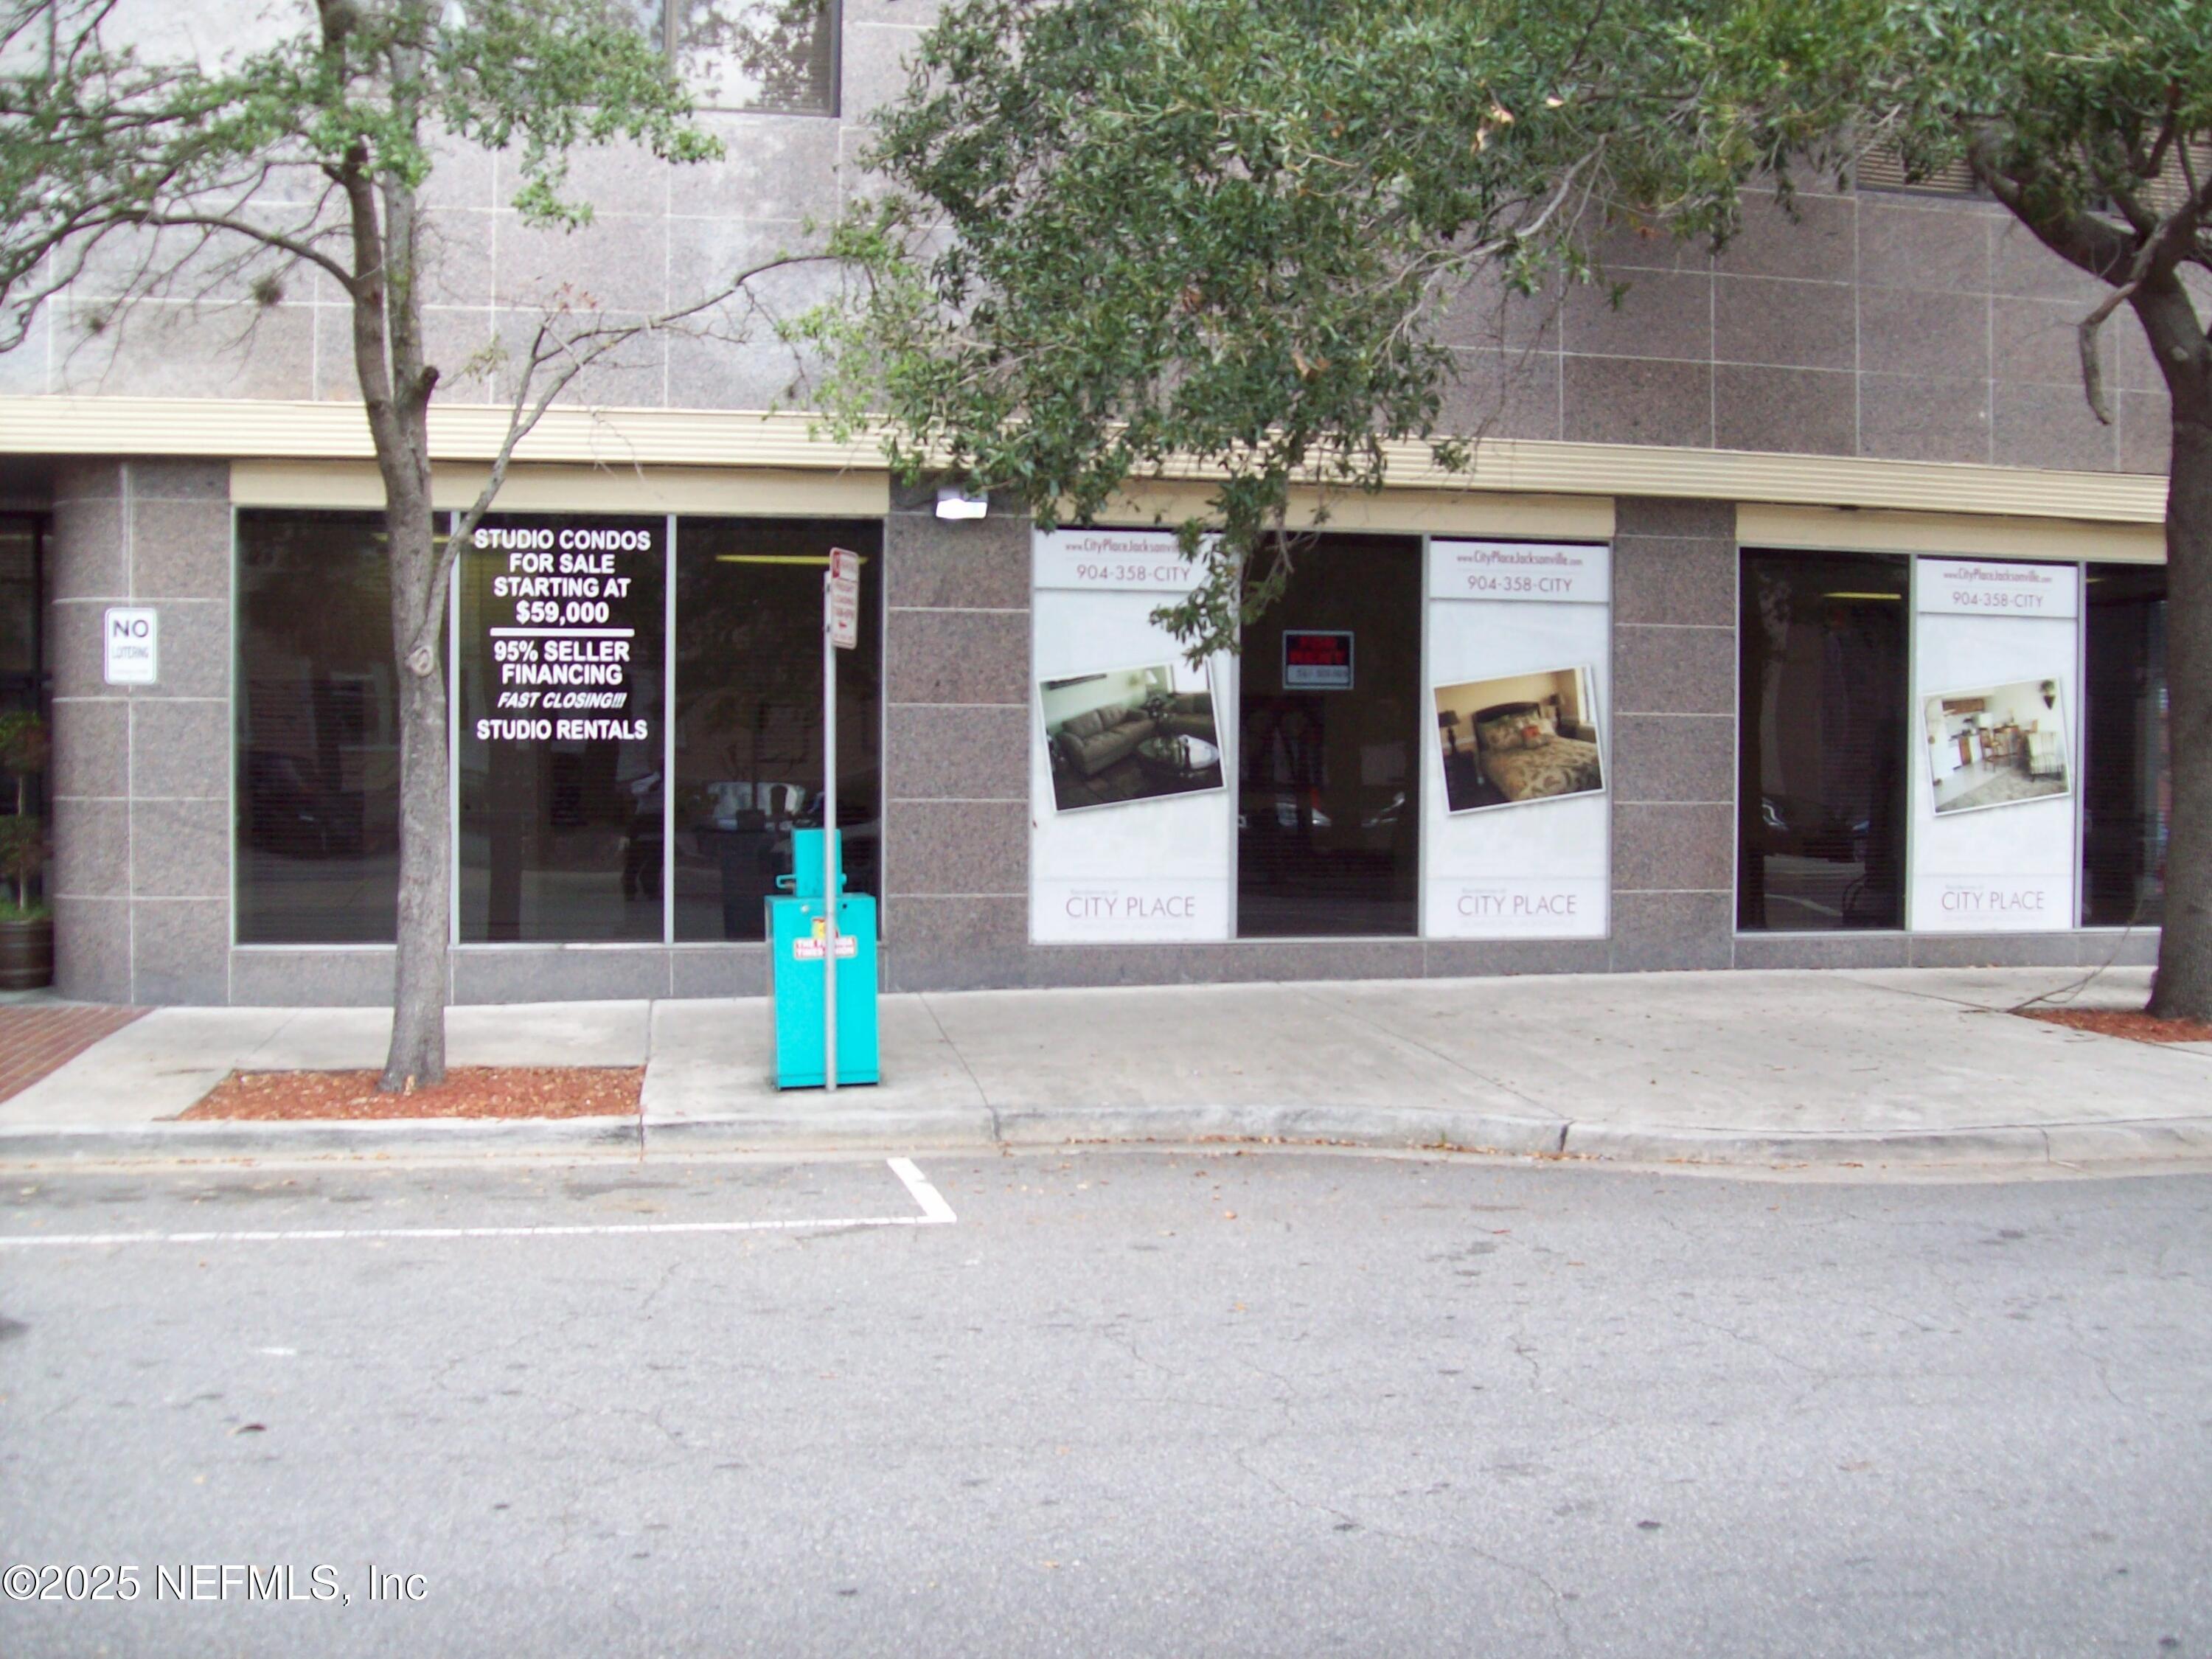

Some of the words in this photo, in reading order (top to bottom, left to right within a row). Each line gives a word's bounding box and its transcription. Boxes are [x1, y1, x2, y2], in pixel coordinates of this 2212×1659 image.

[474, 529, 554, 549] STUDIO
[559, 529, 651, 551] CONDOS
[509, 553, 554, 573] FOR
[559, 554, 615, 574] SALE
[1456, 550, 1583, 566] www.CityPlaceJacksonville.com
[1077, 564, 1191, 582] 904-358-CITY
[494, 577, 599, 597] STARTING
[604, 578, 631, 598] AT
[1467, 575, 1573, 592] 904-358-CITY
[1953, 591, 2044, 608] 904-358-CITY
[515, 599, 610, 626] $59,000
[113, 619, 149, 638] NO
[494, 640, 538, 661] 95%
[544, 641, 630, 662] SELLER
[502, 664, 623, 685] FINANCING
[497, 692, 541, 709] FAST
[543, 692, 627, 709] CLOSING!!!
[477, 720, 552, 740] STUDIO
[557, 720, 648, 740] RENTALS
[1065, 897, 1118, 918] CITY
[1127, 896, 1195, 917] PLACE
[1458, 895, 1506, 916] CITY
[1513, 894, 1577, 915] PLACE
[1941, 891, 1983, 911] CITY
[1990, 891, 2045, 910] PLACE
